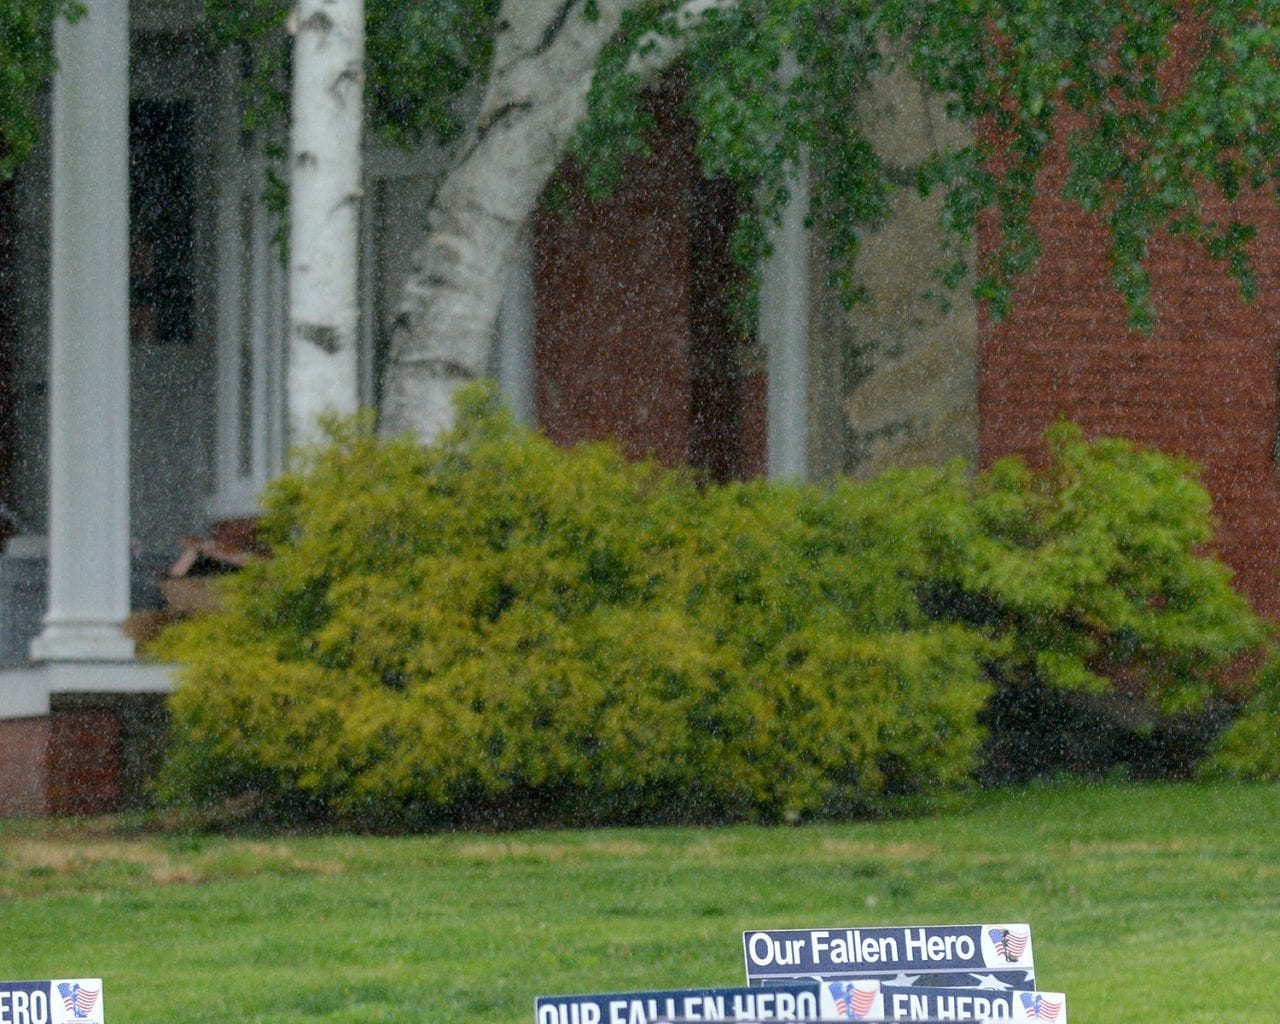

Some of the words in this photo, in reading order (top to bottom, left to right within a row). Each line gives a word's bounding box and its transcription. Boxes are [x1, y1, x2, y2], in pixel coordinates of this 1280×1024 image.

[749, 932, 804, 965] Our
[810, 930, 898, 964] Fallen
[904, 928, 975, 961] Hero
[734, 991, 818, 1020] HERO
[937, 997, 1009, 1021] HERO
